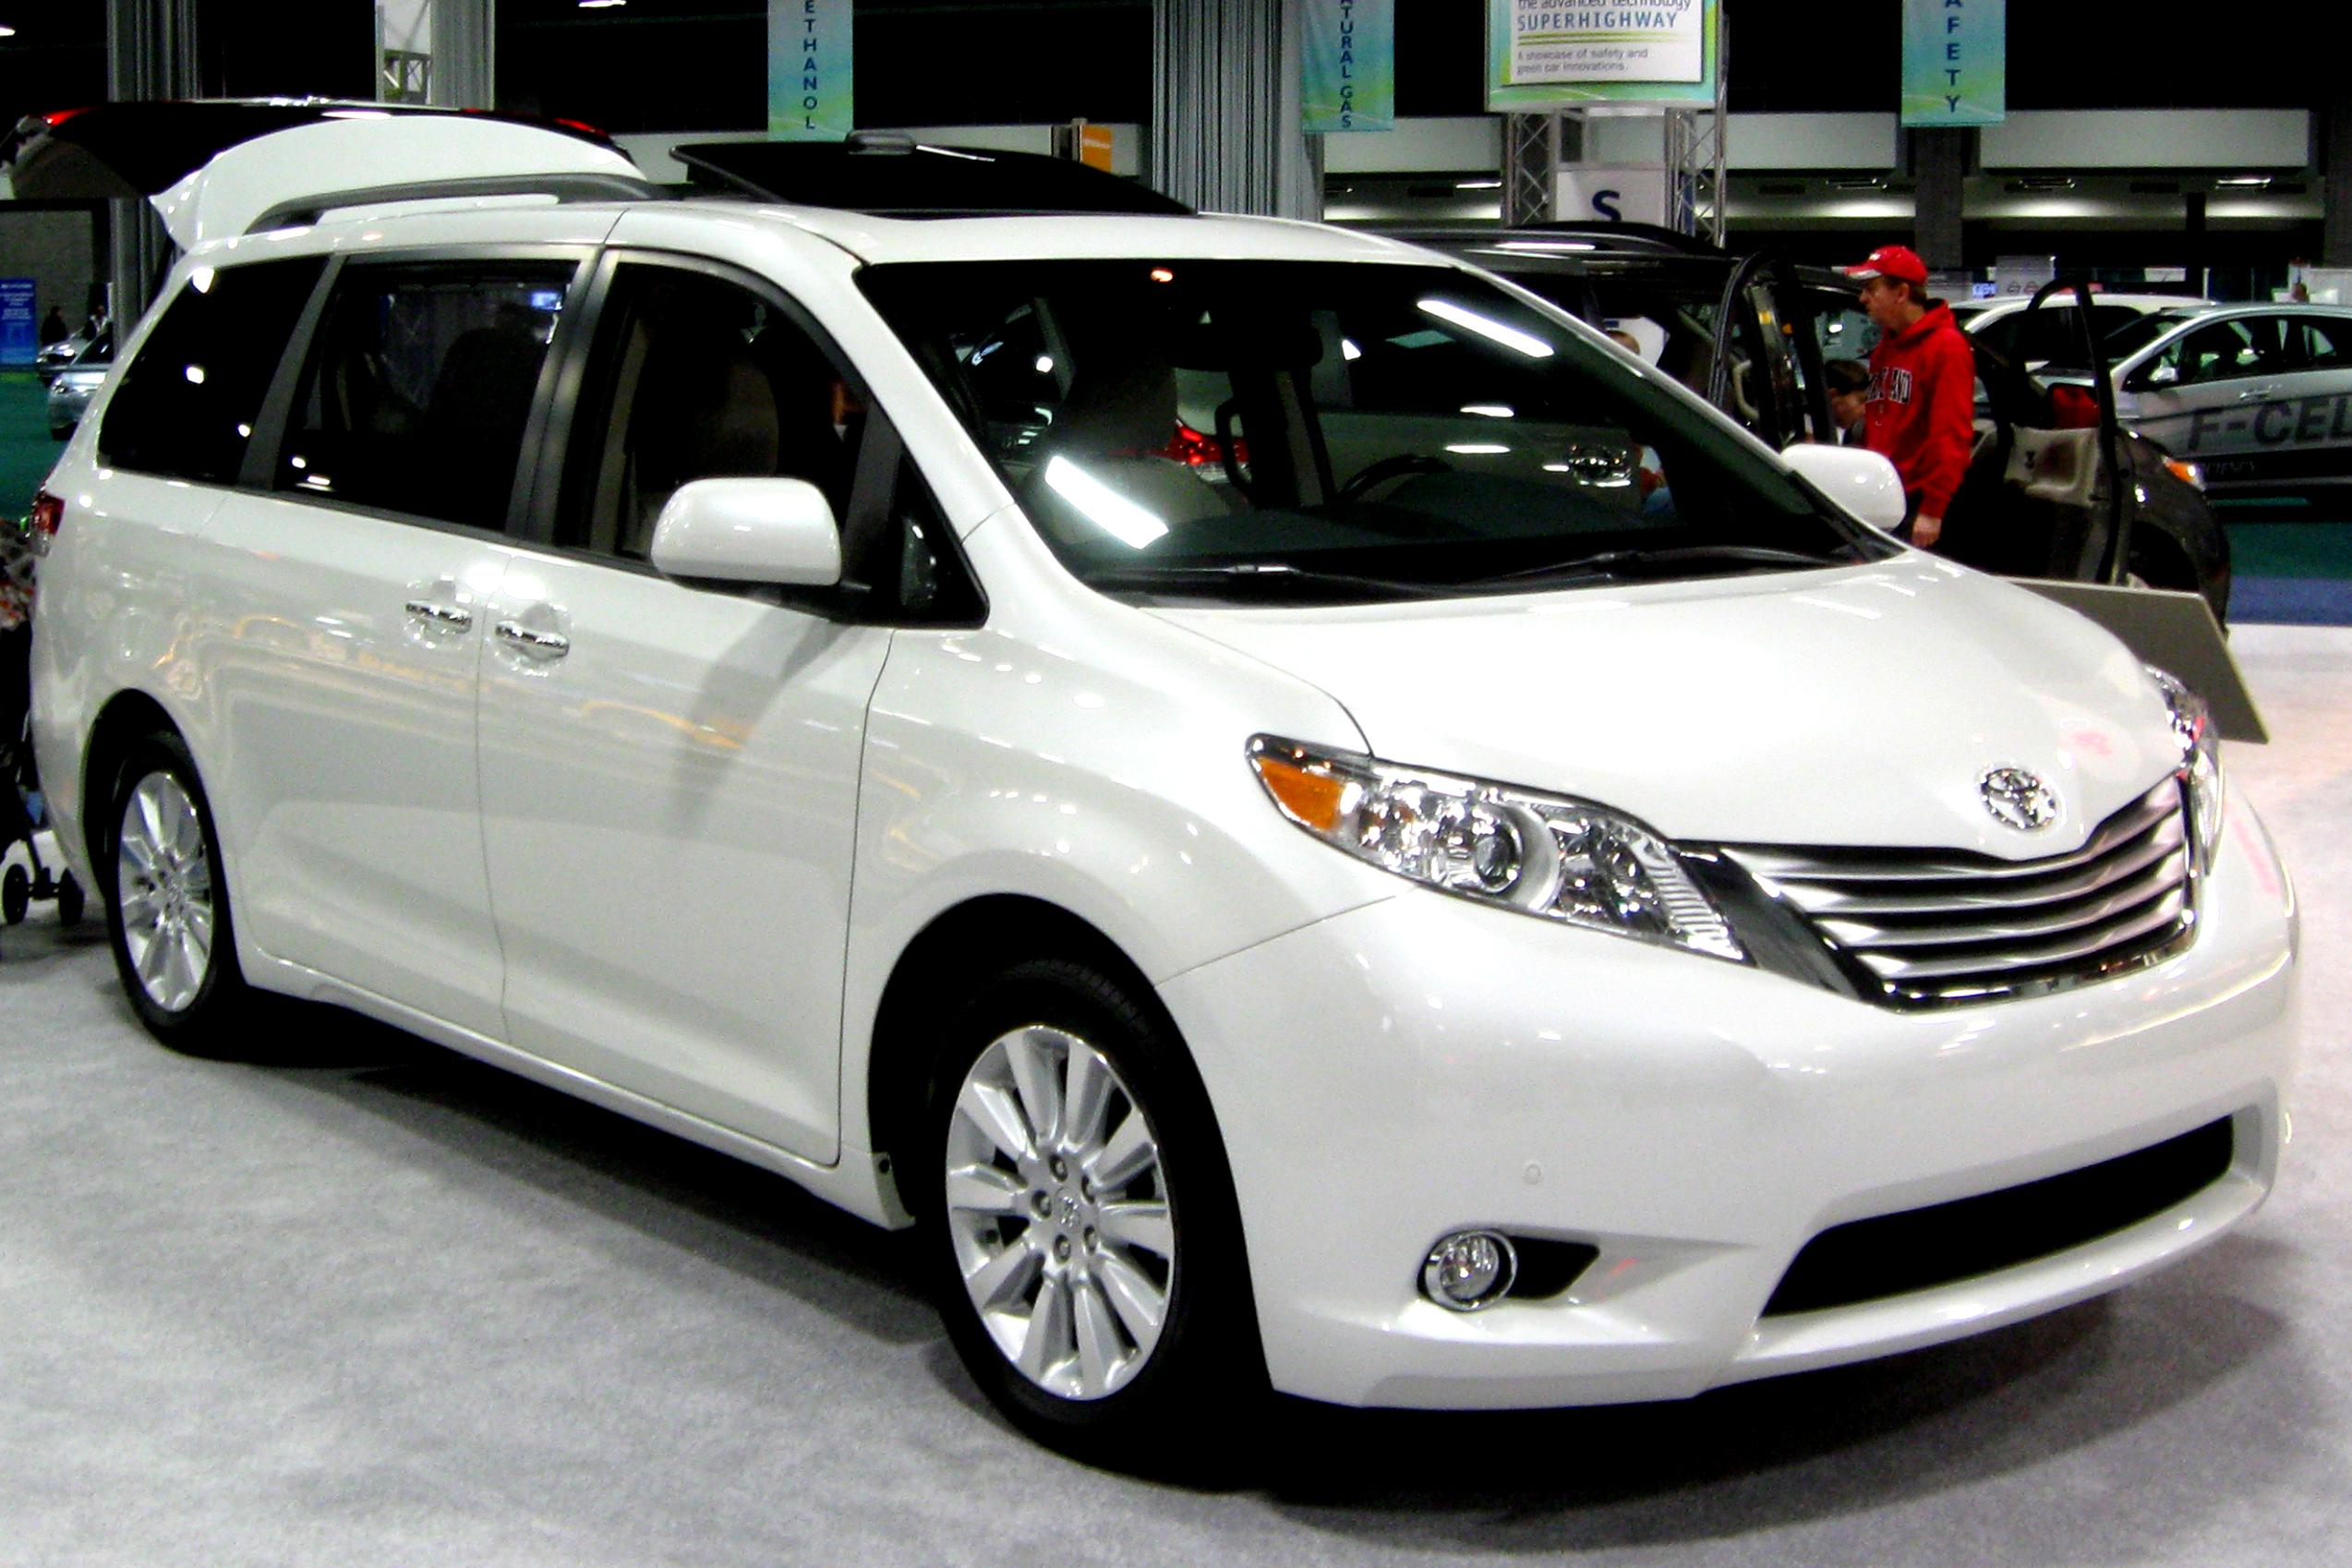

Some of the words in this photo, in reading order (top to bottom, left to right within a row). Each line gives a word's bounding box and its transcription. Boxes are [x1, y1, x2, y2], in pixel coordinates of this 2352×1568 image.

[1517, 11, 1678, 31] SUPERHIGHWAY
[1526, 51, 1574, 61] showcase
[1575, 48, 1588, 59] of
[1590, 47, 1624, 60] safety
[1626, 48, 1648, 59] and
[802, 0, 817, 129] ETHANOL
[1516, 64, 1543, 76] green
[1544, 63, 1561, 73] car
[1339, 85, 1354, 128] GAS
